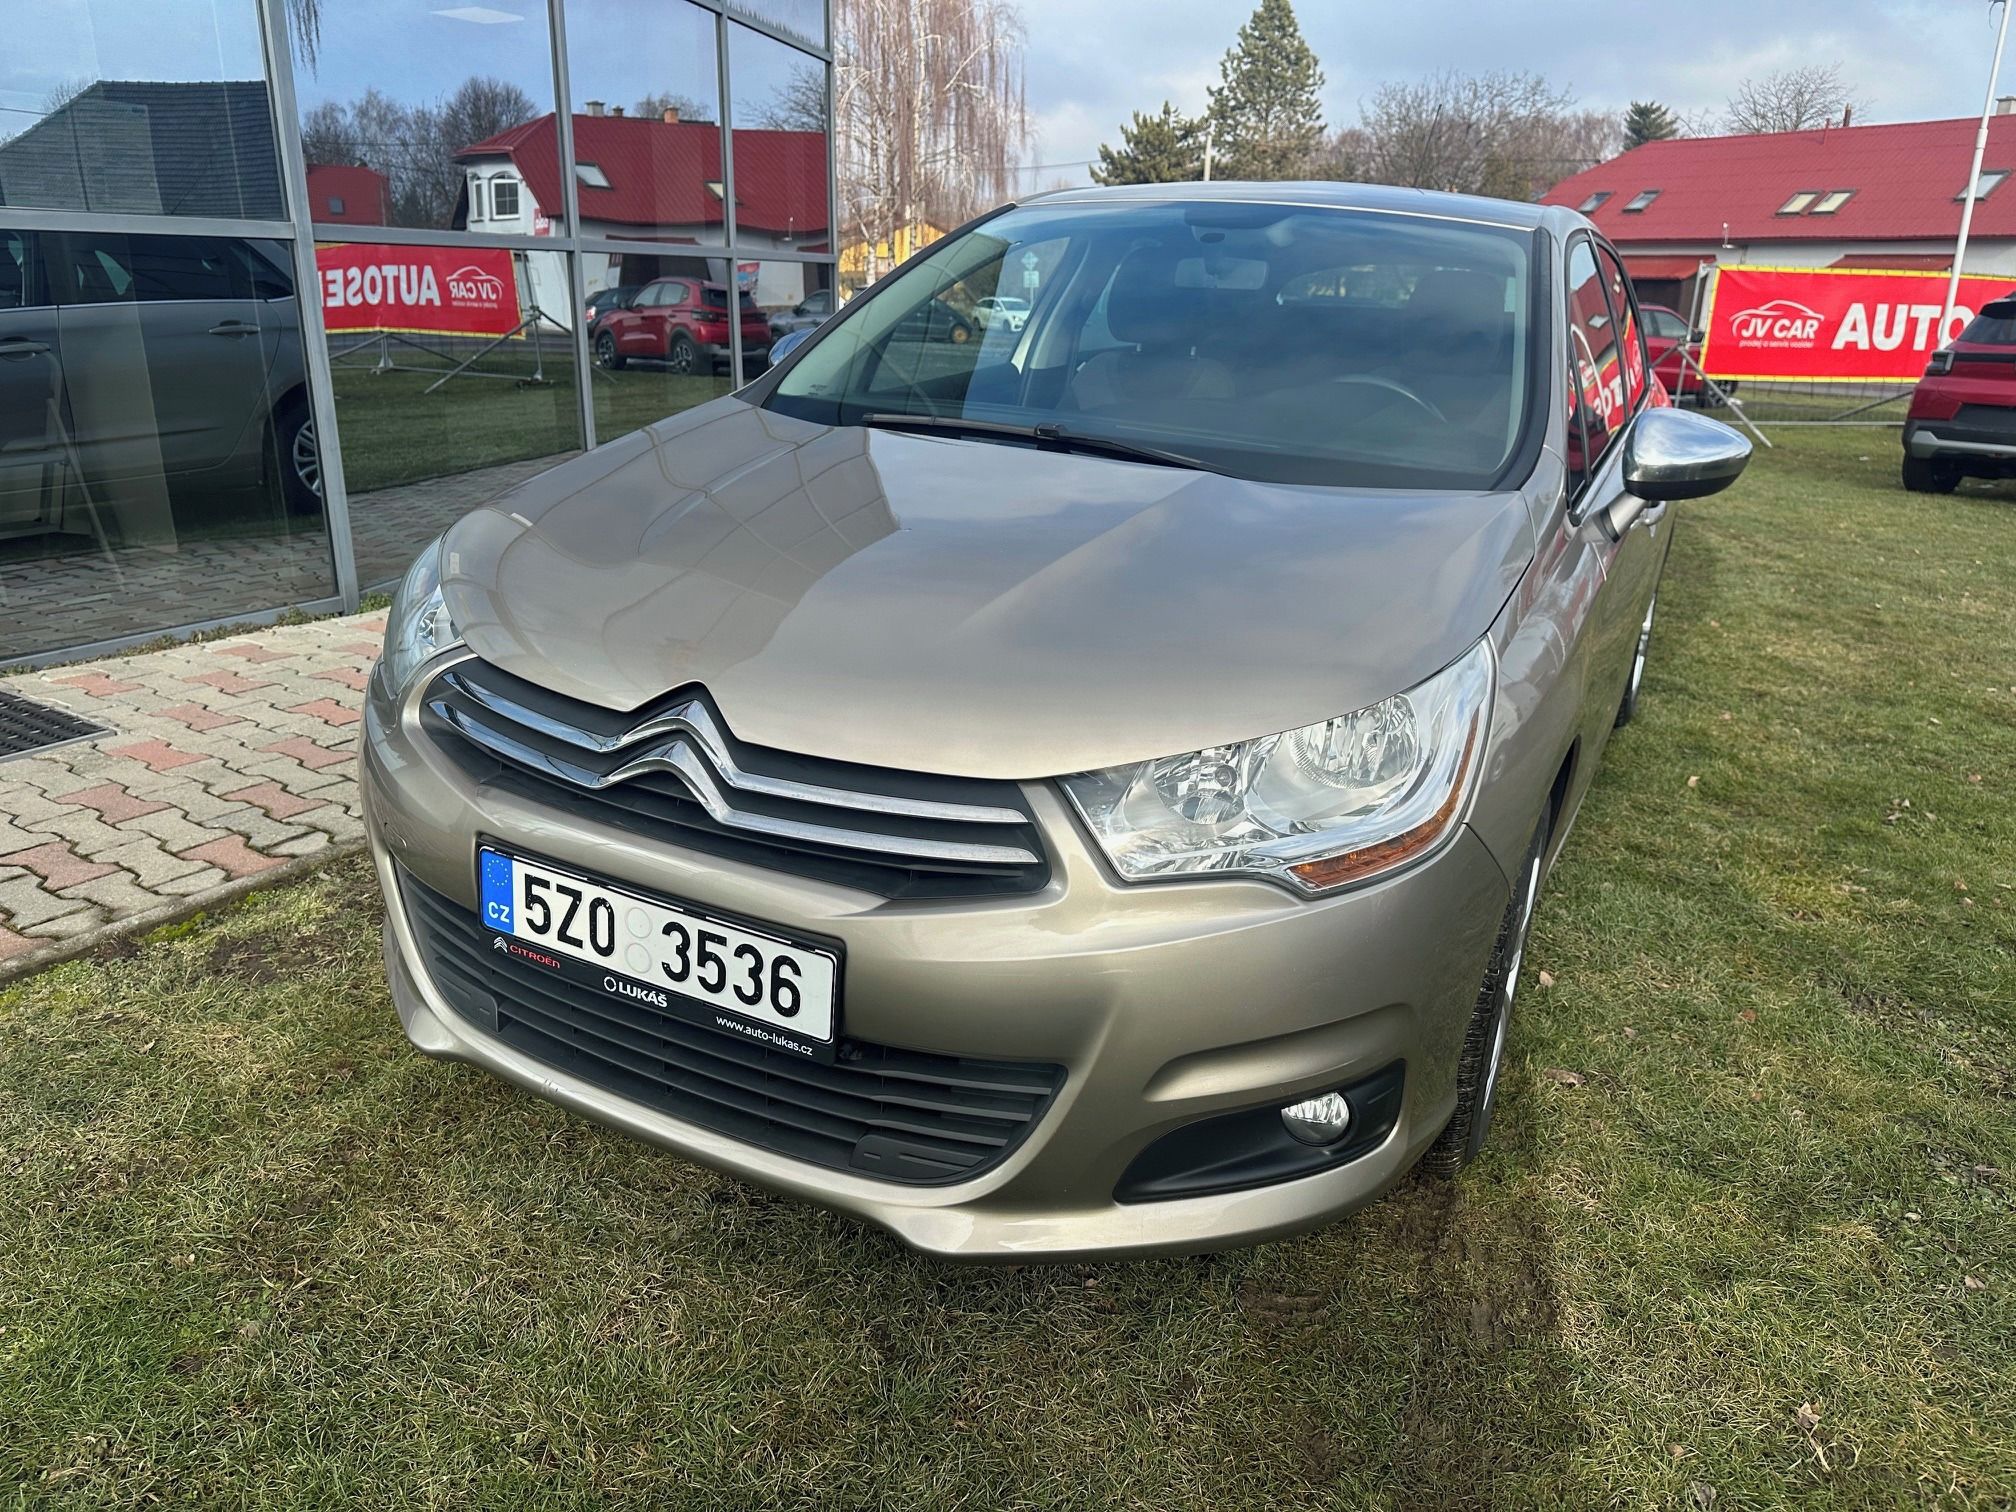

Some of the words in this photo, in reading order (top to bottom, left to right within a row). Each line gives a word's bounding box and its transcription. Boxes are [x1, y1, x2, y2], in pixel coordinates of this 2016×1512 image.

[1741, 317, 1774, 338] JV
[1773, 317, 1819, 339] CAR
[488, 900, 510, 923] CZ
[524, 872, 616, 957] 5Z0
[661, 920, 802, 1018] 3536
[618, 981, 668, 1008] LUKÁŠ
[715, 1016, 813, 1056] www.auto-lukas.cz
